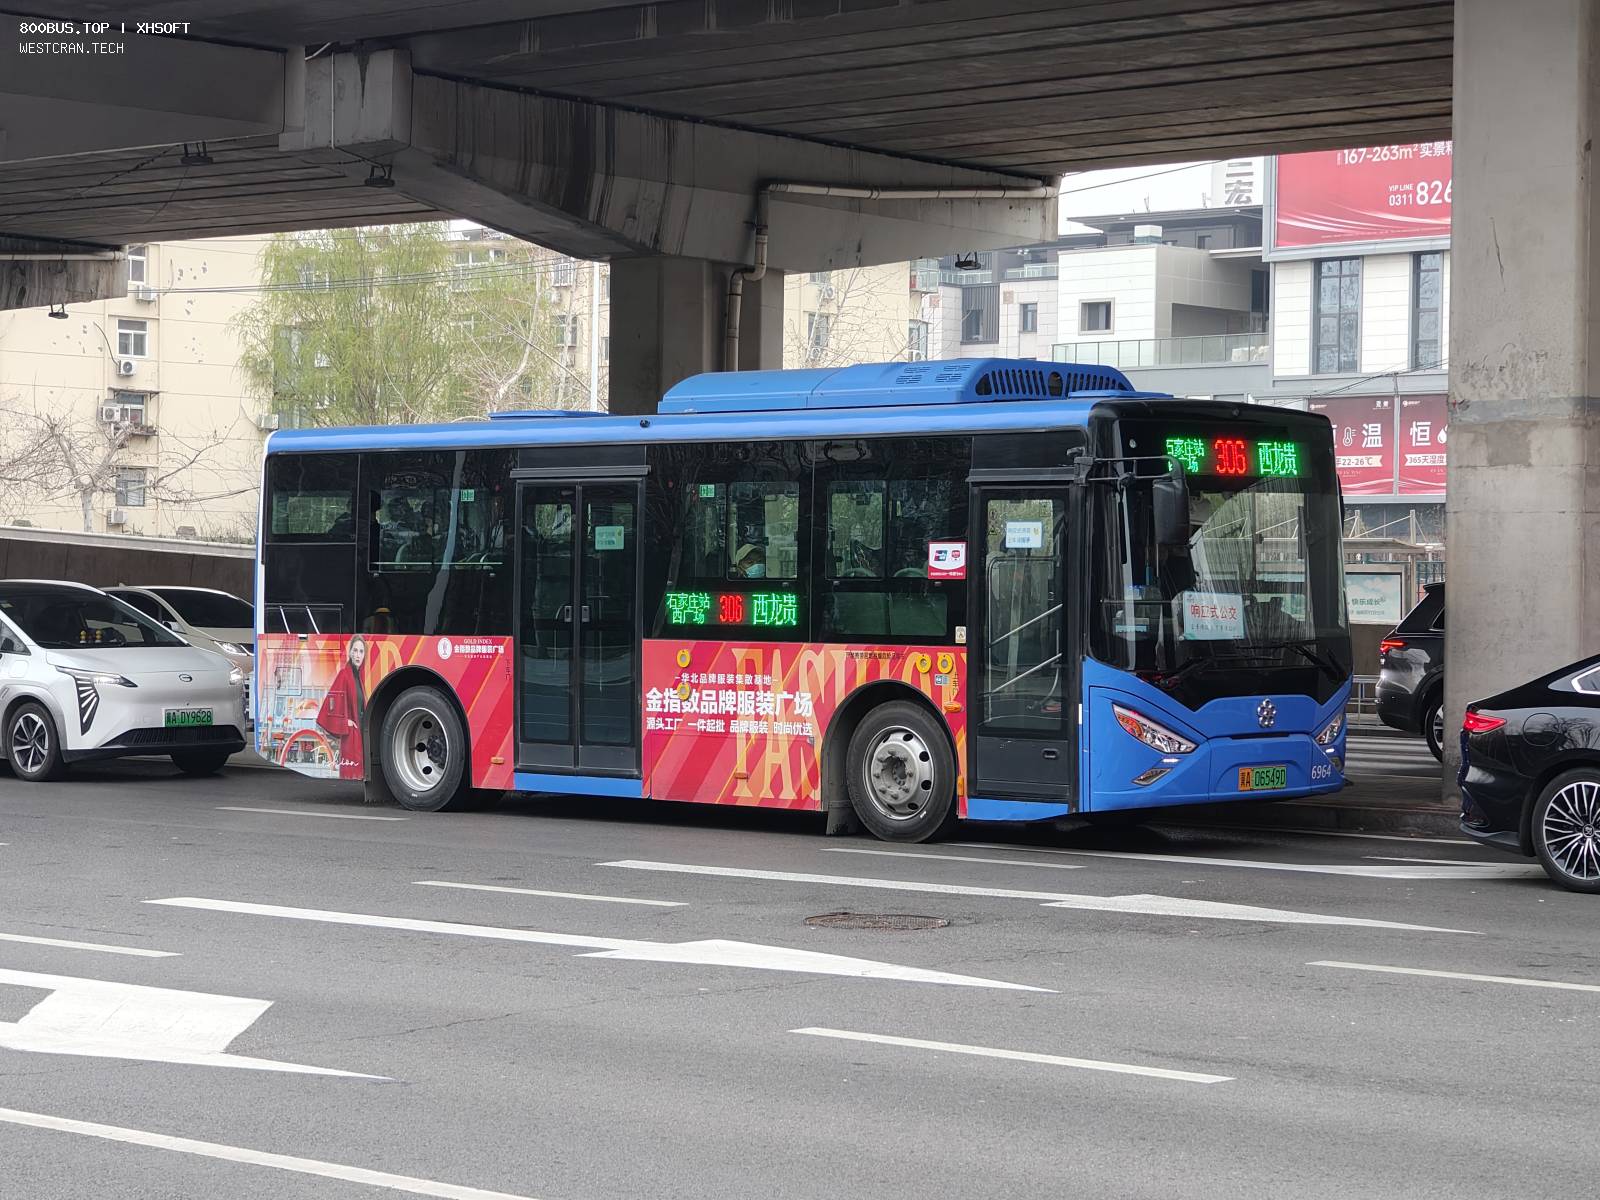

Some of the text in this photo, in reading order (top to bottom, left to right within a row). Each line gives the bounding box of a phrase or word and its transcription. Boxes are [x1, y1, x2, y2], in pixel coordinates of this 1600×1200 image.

[1389, 193, 1413, 206] 0311
[1410, 421, 1432, 447] 恒
[1215, 440, 1246, 474] 306
[667, 592, 798, 625] 石家庄站 306 西龙贵
[672, 607, 705, 624] 西广场
[646, 717, 813, 736] 源头工厂 一件起批 品牌服装 时尚优选
[1311, 765, 1331, 779] 6964
